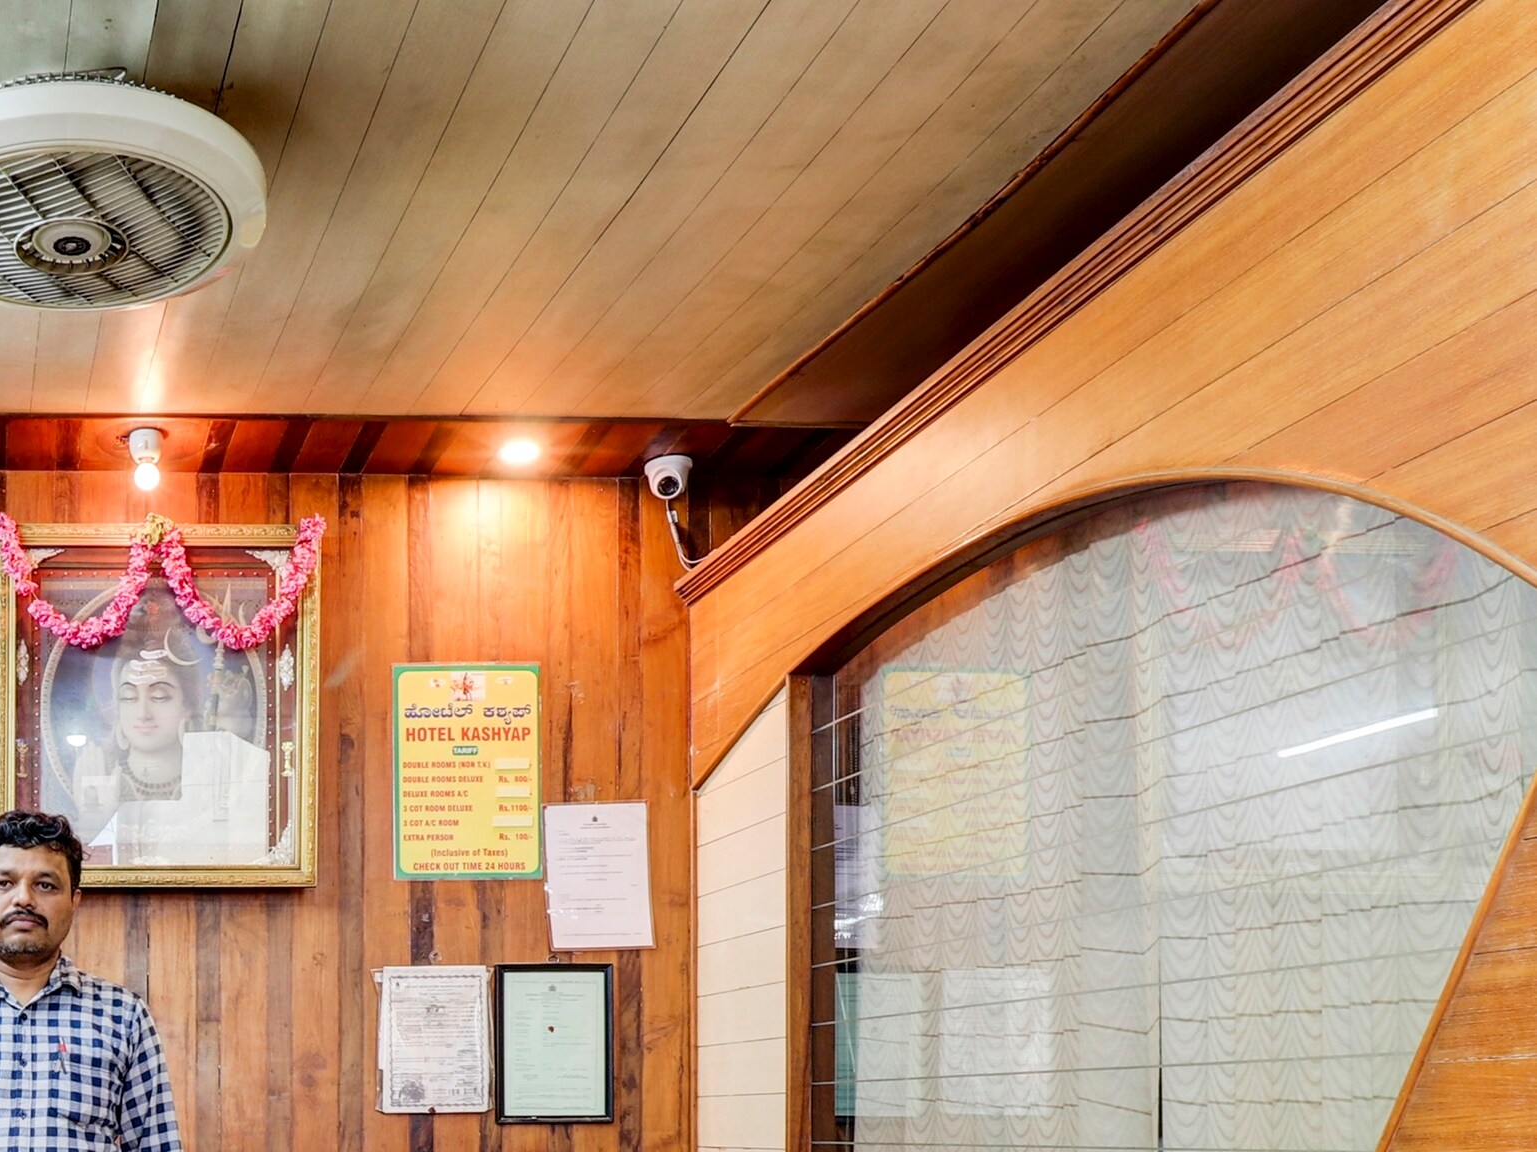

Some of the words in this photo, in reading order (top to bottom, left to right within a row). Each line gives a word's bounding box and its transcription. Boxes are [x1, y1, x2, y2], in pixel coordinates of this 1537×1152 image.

[405, 727, 455, 742] HOTEL
[461, 727, 531, 742] KASHYAP
[453, 746, 478, 755] TARIFF
[402, 761, 429, 769] DOUBLE
[431, 761, 456, 769] ROOMS
[458, 761, 475, 770] (NON
[402, 775, 429, 784] DOUBLE
[431, 775, 456, 783] ROOMS
[458, 775, 484, 783] DELUXE
[498, 775, 510, 783] Rs.
[402, 790, 428, 798] DELUXE
[499, 832, 511, 841] Rs.
[430, 848, 470, 858] (Inclusive
[472, 848, 481, 857] of
[483, 848, 508, 858] Taxes)
[413, 862, 441, 871] CHECK
[444, 862, 460, 871] OUT
[463, 862, 483, 871] TIME
[485, 862, 496, 871] 24
[498, 862, 526, 871] HOURS
